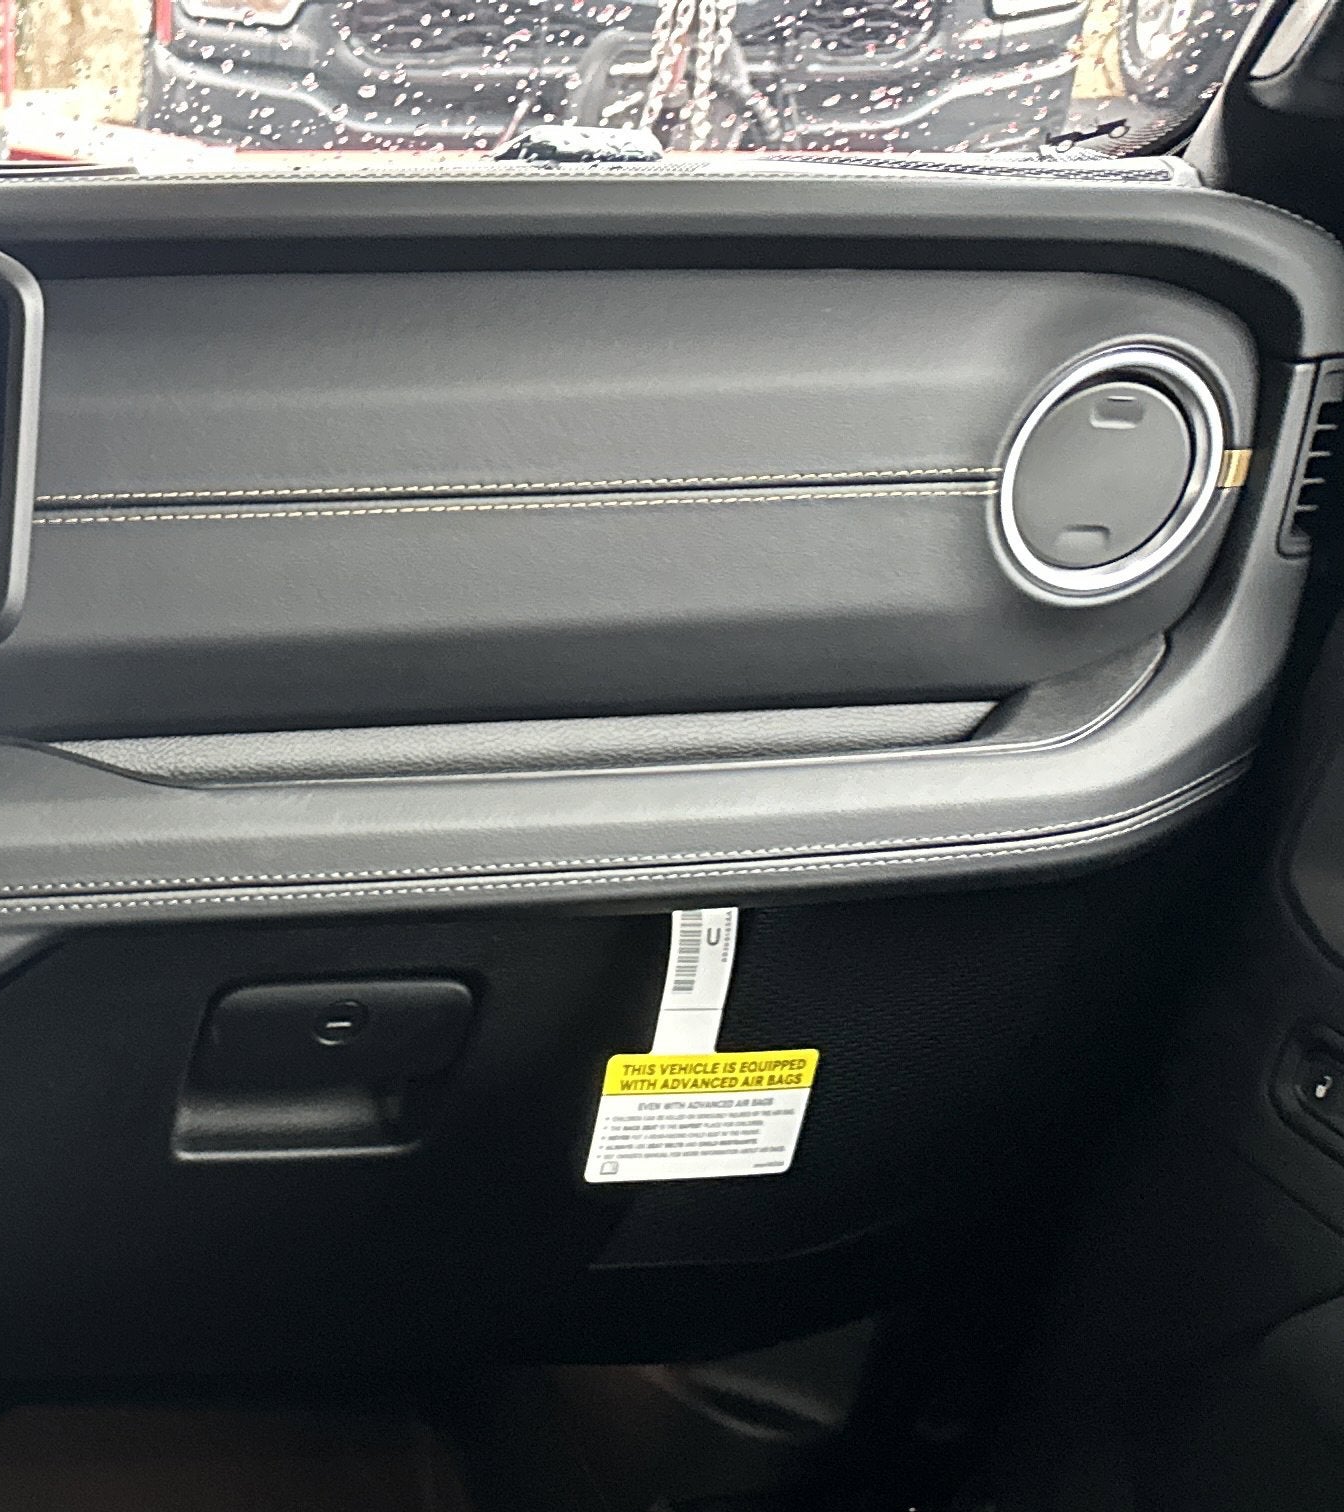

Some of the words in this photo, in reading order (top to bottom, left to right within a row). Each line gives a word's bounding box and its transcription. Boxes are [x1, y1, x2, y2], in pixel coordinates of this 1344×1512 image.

[706, 927, 722, 946] U
[622, 1063, 655, 1077] THIS
[660, 1061, 720, 1076] VEHICLE
[722, 1061, 737, 1074] IS
[738, 1058, 807, 1073] EQUIPPED
[619, 1078, 657, 1091] WITH
[661, 1076, 739, 1090] ADVANCED
[740, 1074, 764, 1088] AIR
[766, 1073, 802, 1087] BAGS
